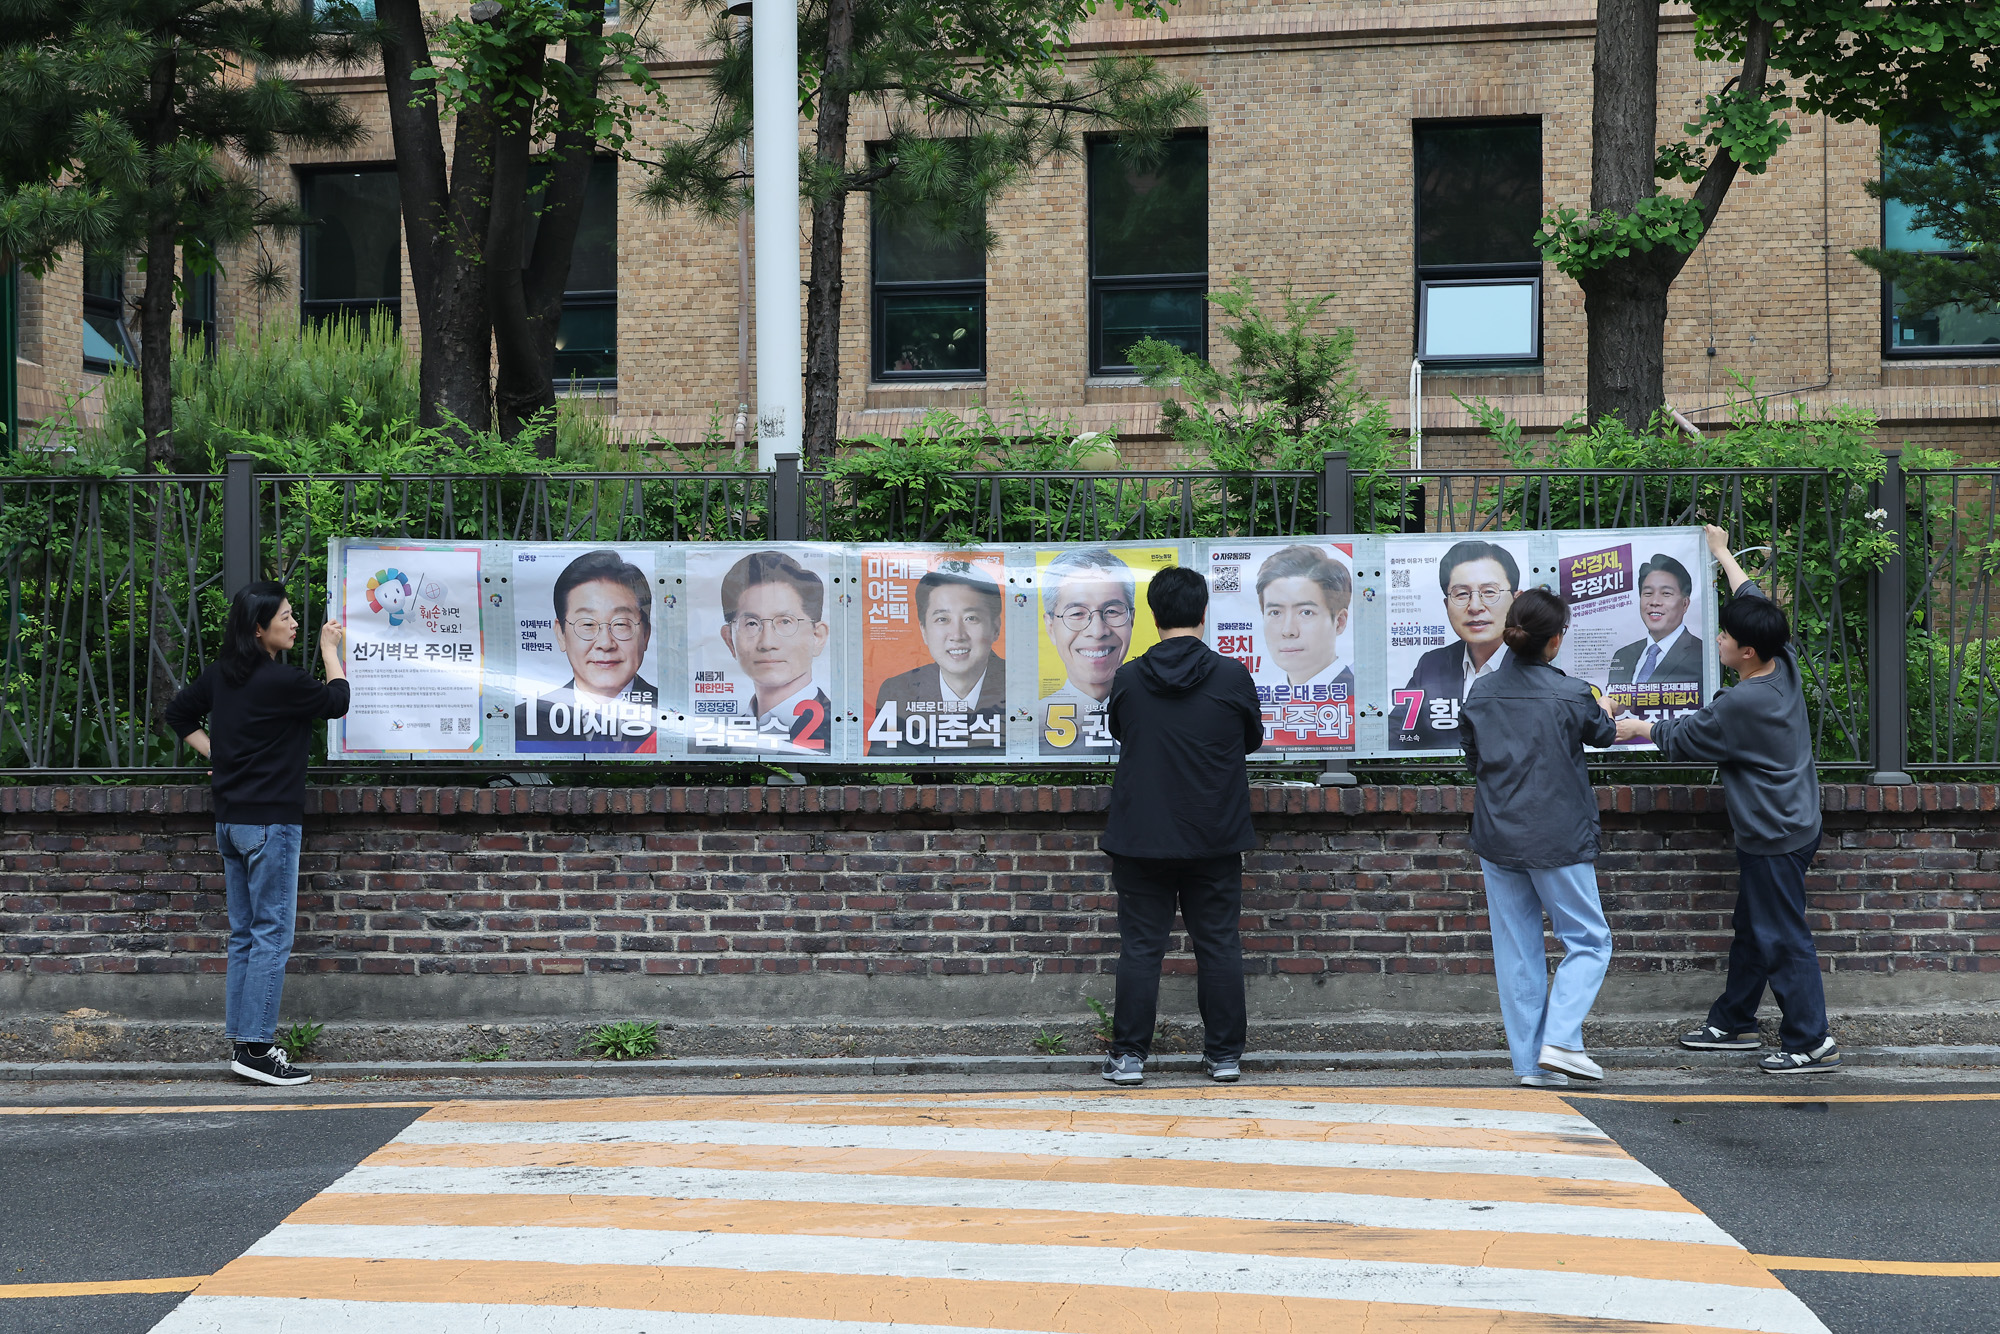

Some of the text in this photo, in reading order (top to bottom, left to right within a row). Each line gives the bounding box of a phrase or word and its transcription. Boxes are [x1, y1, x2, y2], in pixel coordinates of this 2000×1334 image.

[1220, 552, 1252, 560] 자유통일당
[868, 558, 928, 580] 미래를
[1571, 550, 1623, 578] 선경제,
[1571, 570, 1624, 599] 후정치!
[868, 581, 908, 602] 여는
[419, 605, 460, 619] 훼손하면
[868, 603, 909, 624] 선택
[426, 621, 462, 634] 안 돼요!
[520, 620, 552, 629] 이제부터
[1217, 622, 1253, 631] 광화문정신
[1391, 625, 1446, 636] 부정선거 척결로
[521, 631, 537, 640] 진짜
[1391, 636, 1445, 647] 청년에게 미래를
[521, 642, 553, 652] 대한민국
[1217, 635, 1253, 654] 정치
[353, 642, 474, 662] 선거벽보 주의문
[695, 671, 725, 682] 새롭게
[695, 683, 735, 694] 대한민국
[1637, 683, 1660, 692] 준비된
[621, 691, 653, 702] 지금은
[1662, 692, 1699, 705] 해결사
[522, 690, 653, 737] 1 이재명
[697, 702, 736, 713] 정정당당
[1393, 689, 1461, 731] 7 황
[694, 699, 825, 750] 김문수 2
[867, 700, 1001, 748] 4 이준석
[1044, 703, 1121, 748] 5 권
[1259, 703, 1353, 740] 구주와
[1399, 734, 1420, 742] 무소속
